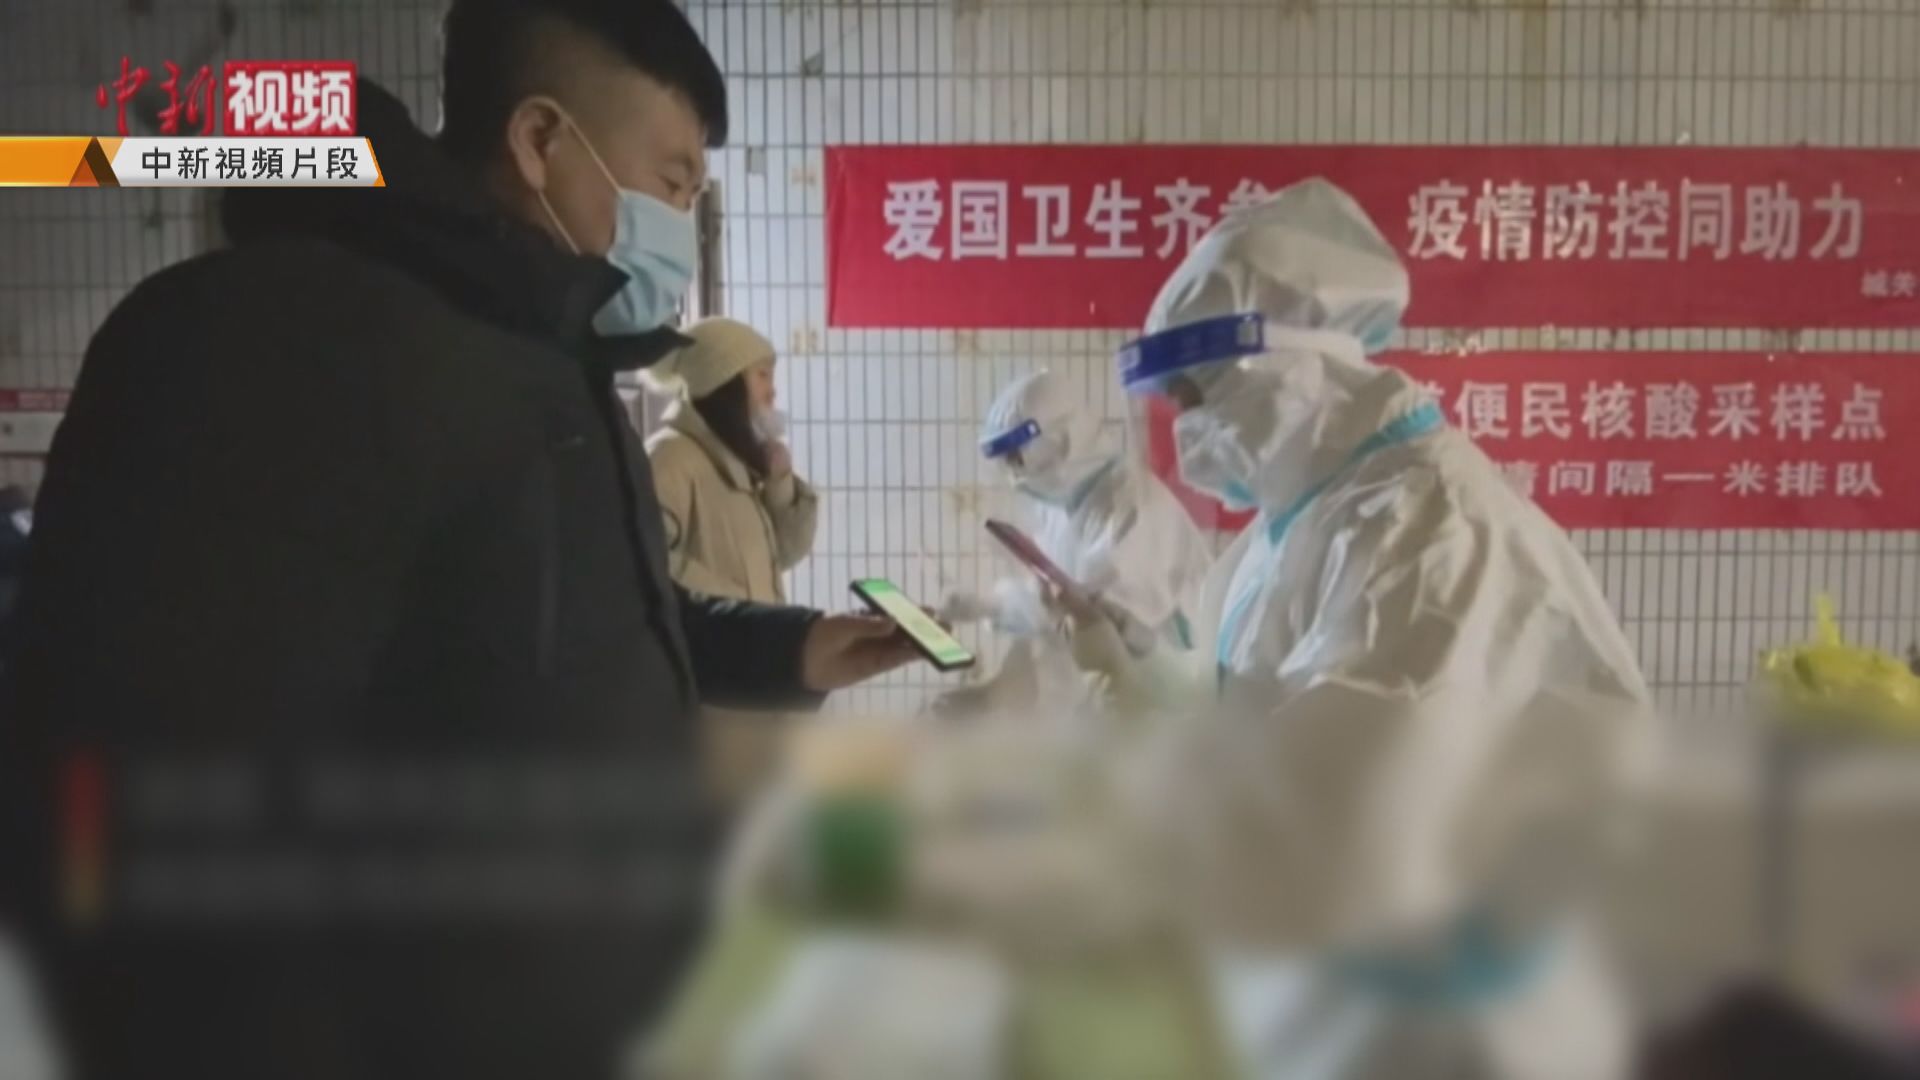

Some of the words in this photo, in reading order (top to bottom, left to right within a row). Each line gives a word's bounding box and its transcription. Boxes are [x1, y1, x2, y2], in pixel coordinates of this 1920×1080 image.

[1407, 178, 1863, 261] 疫情防控同助力
[1417, 380, 1887, 440] 便民核酸采样点
